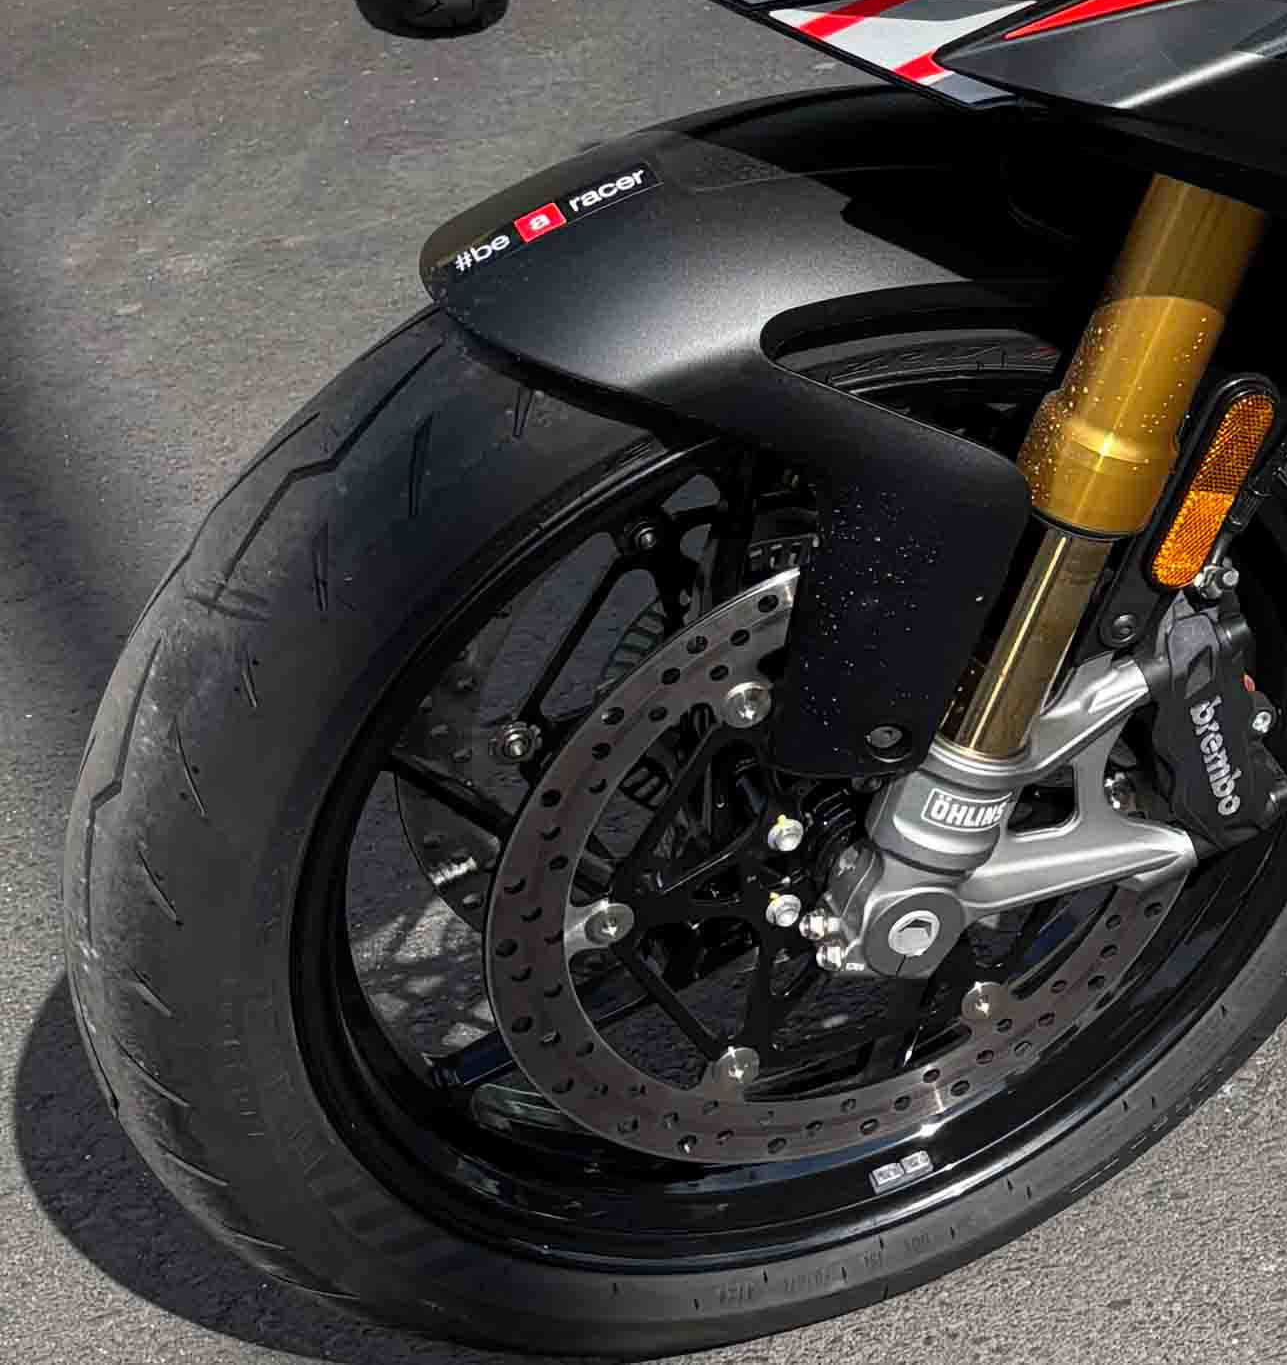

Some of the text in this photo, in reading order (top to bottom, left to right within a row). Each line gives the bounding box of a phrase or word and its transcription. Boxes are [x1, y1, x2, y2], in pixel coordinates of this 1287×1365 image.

[454, 168, 645, 273] #be a racer
[1189, 696, 1243, 818] brembo
